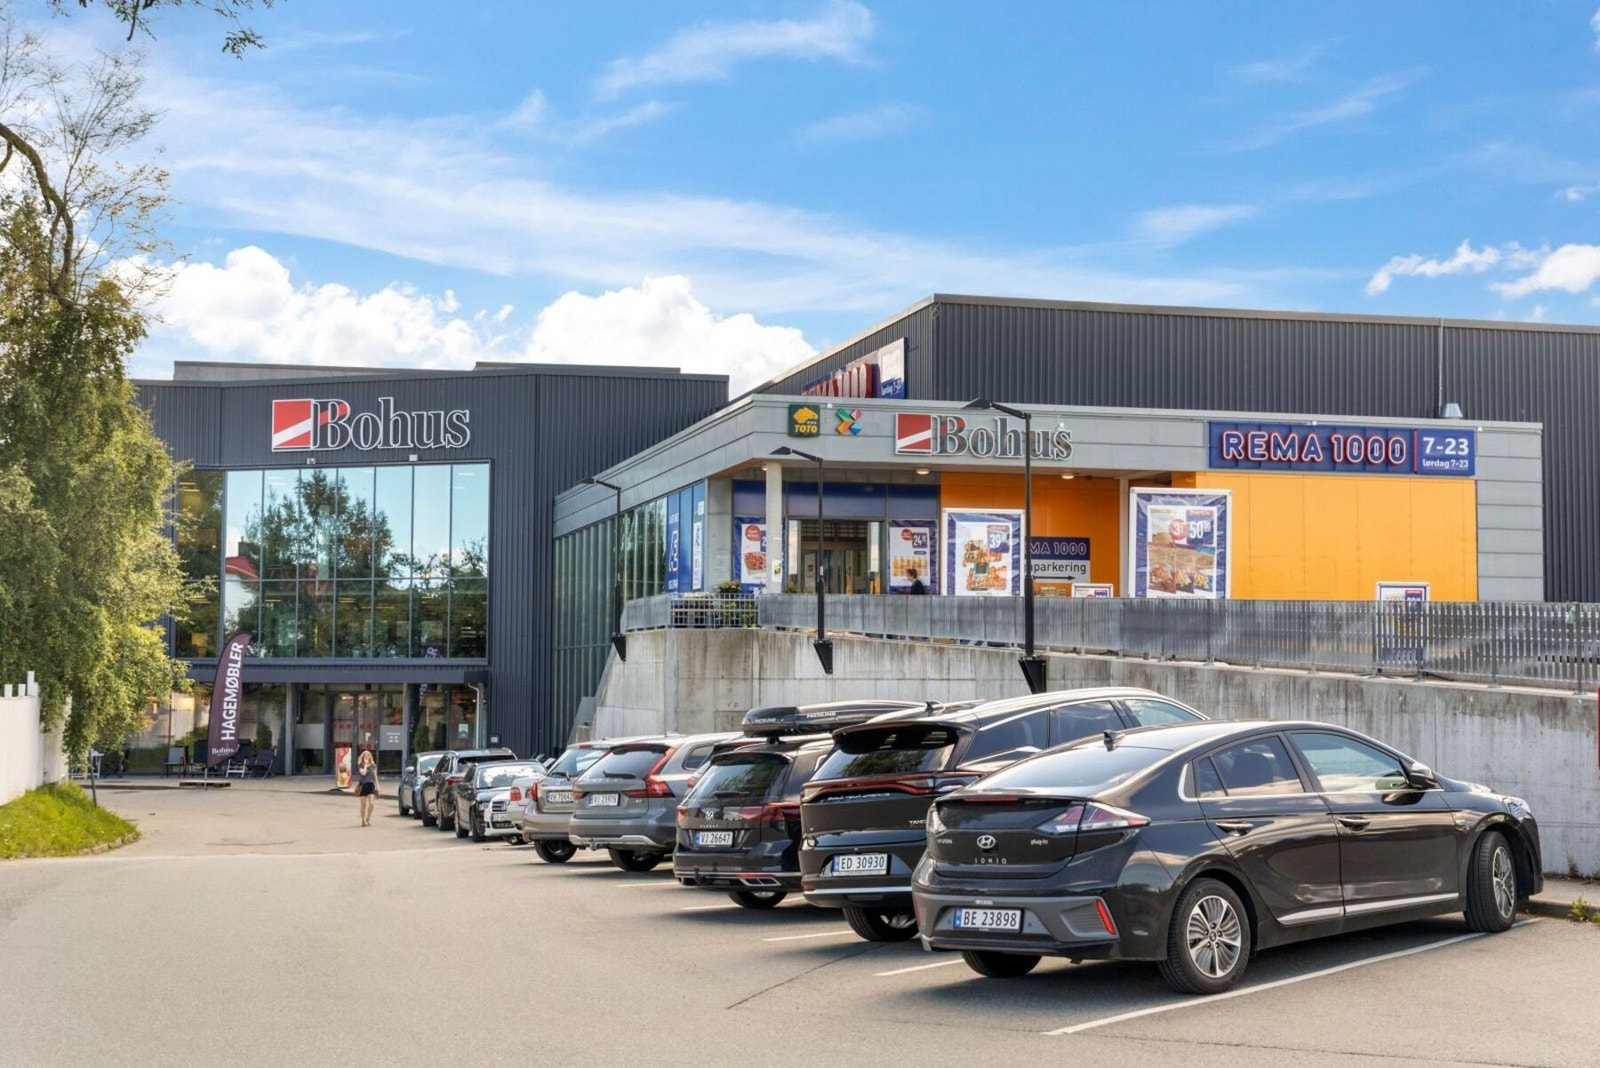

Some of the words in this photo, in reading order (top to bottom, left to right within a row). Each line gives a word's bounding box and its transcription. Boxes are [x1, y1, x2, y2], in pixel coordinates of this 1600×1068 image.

[312, 396, 471, 451] Bohus
[794, 424, 818, 433] TOTO
[932, 415, 1073, 461] Bohus
[1422, 436, 1469, 456] 7-23
[1222, 431, 1324, 462] REMA
[1330, 434, 1407, 465] 1000
[1450, 459, 1469, 468] 7-23
[1030, 541, 1051, 555] MA
[1053, 542, 1087, 556] 1000
[221, 642, 244, 741] HAGEMØBLER
[841, 857, 853, 869] ED
[856, 856, 885, 869] 30930
[963, 911, 977, 926] BE
[981, 911, 1017, 927] 23898
